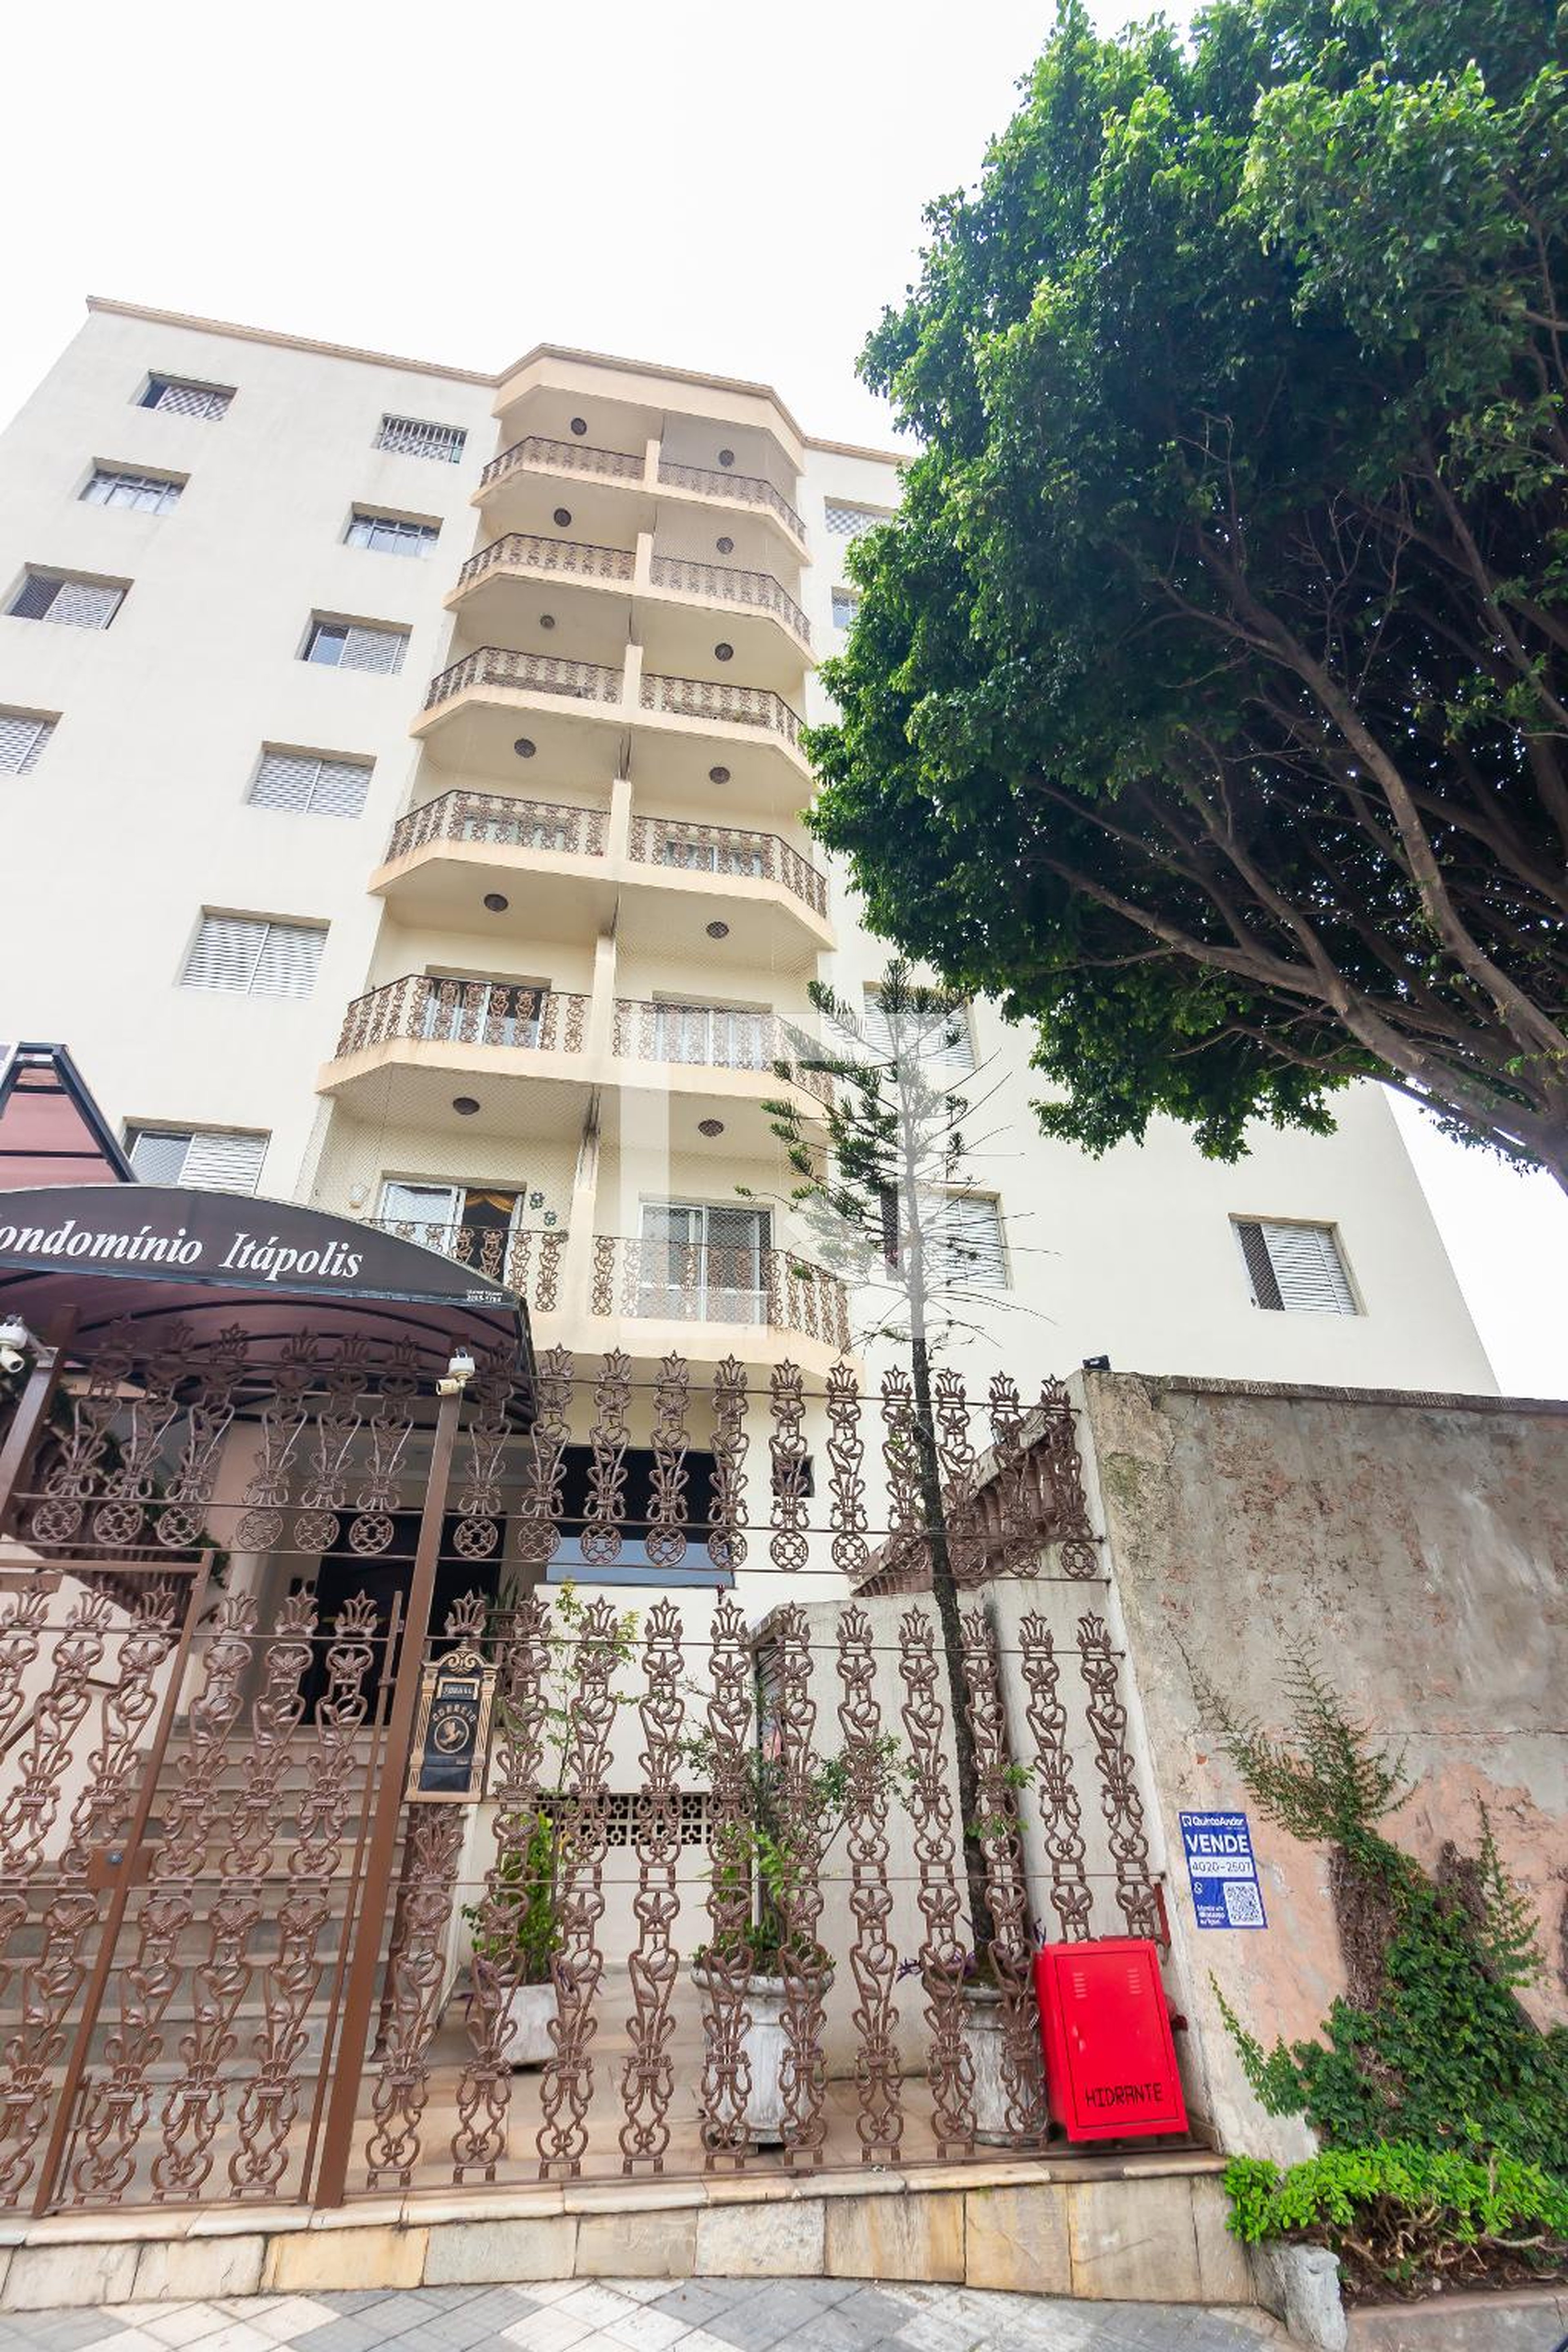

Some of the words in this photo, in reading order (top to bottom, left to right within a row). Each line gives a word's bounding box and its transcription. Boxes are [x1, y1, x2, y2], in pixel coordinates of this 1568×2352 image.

[0, 1219, 203, 1264] ondomínio
[218, 1232, 363, 1281] Itápolis
[1185, 1834, 1250, 1853] VENDE
[1085, 2082, 1164, 2107] HIDRANTE
